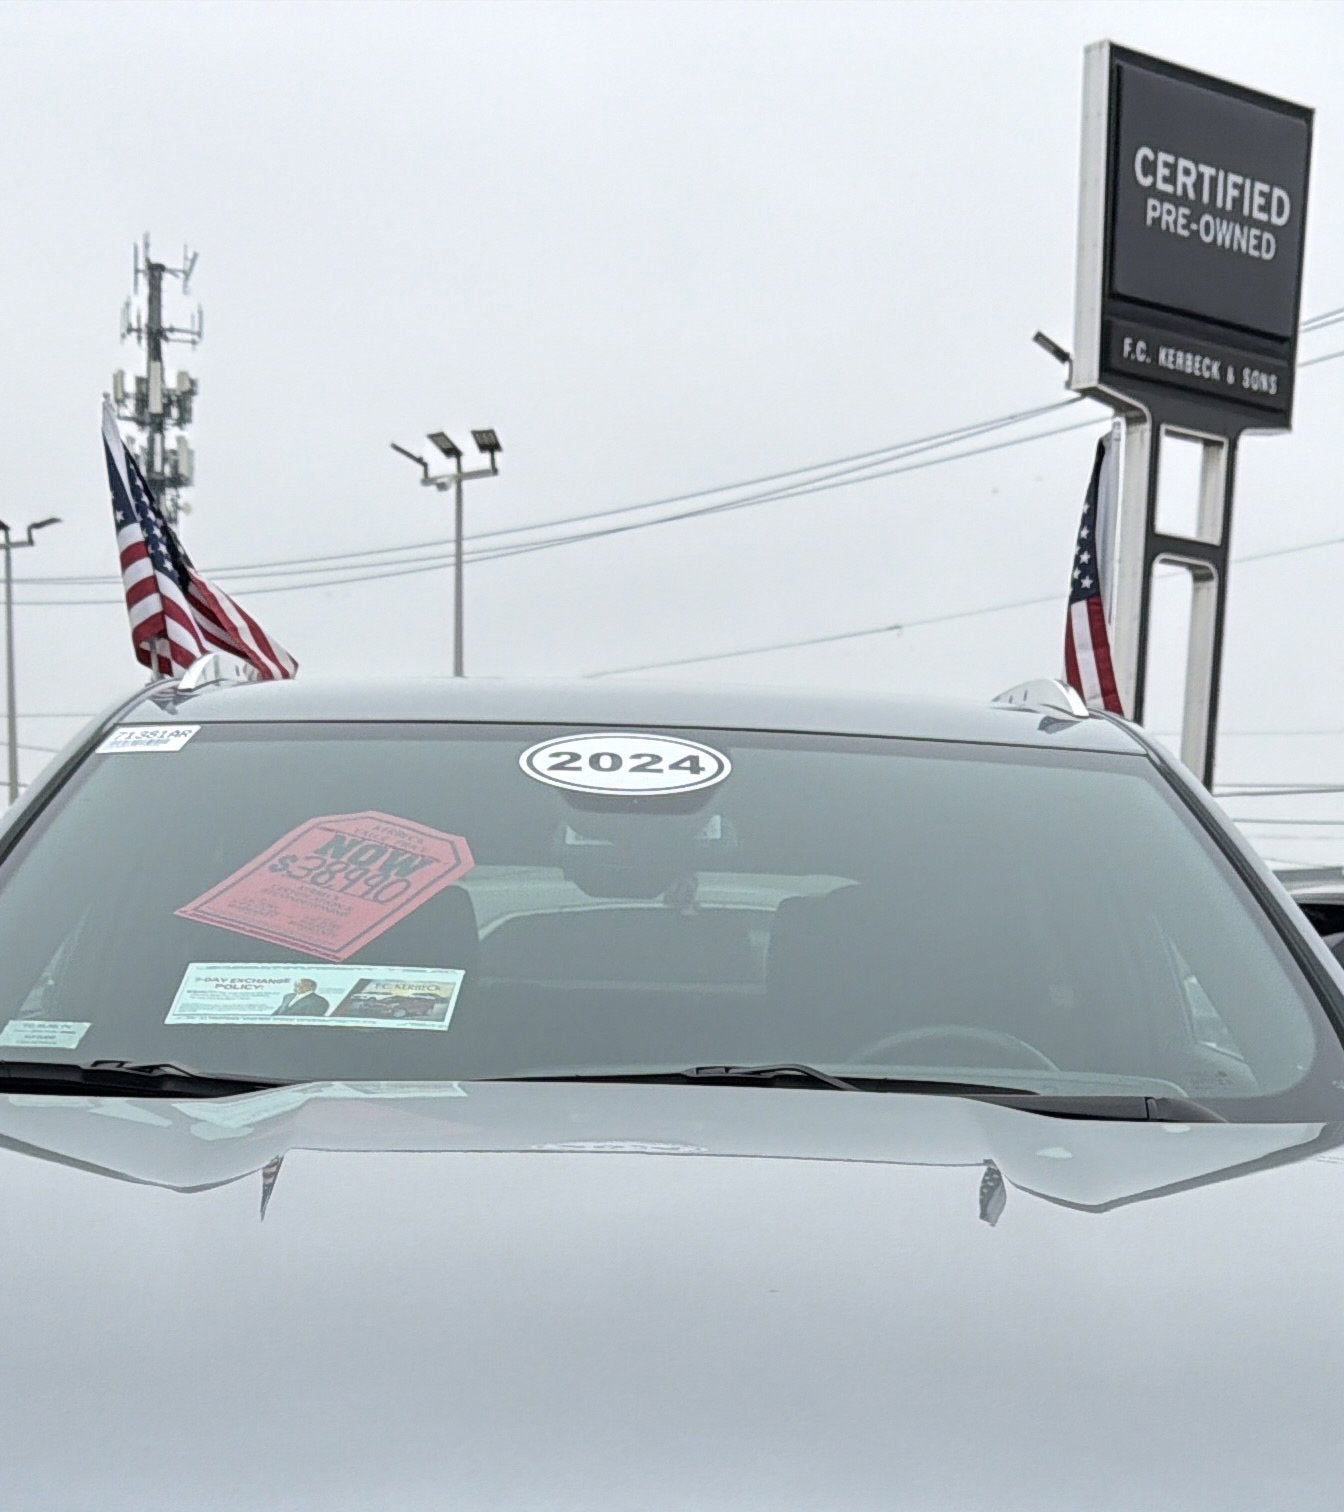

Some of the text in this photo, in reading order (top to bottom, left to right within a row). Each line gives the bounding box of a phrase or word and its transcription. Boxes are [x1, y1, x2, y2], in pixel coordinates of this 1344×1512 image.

[1134, 146, 1291, 227] CERTIFIED
[1146, 198, 1277, 261] PRE-OWNED
[1122, 336, 1152, 364] F.C.
[1158, 345, 1222, 381] KERBECK
[1242, 367, 1278, 395] SONS
[546, 751, 706, 775] 2024
[314, 834, 434, 878] NOW
